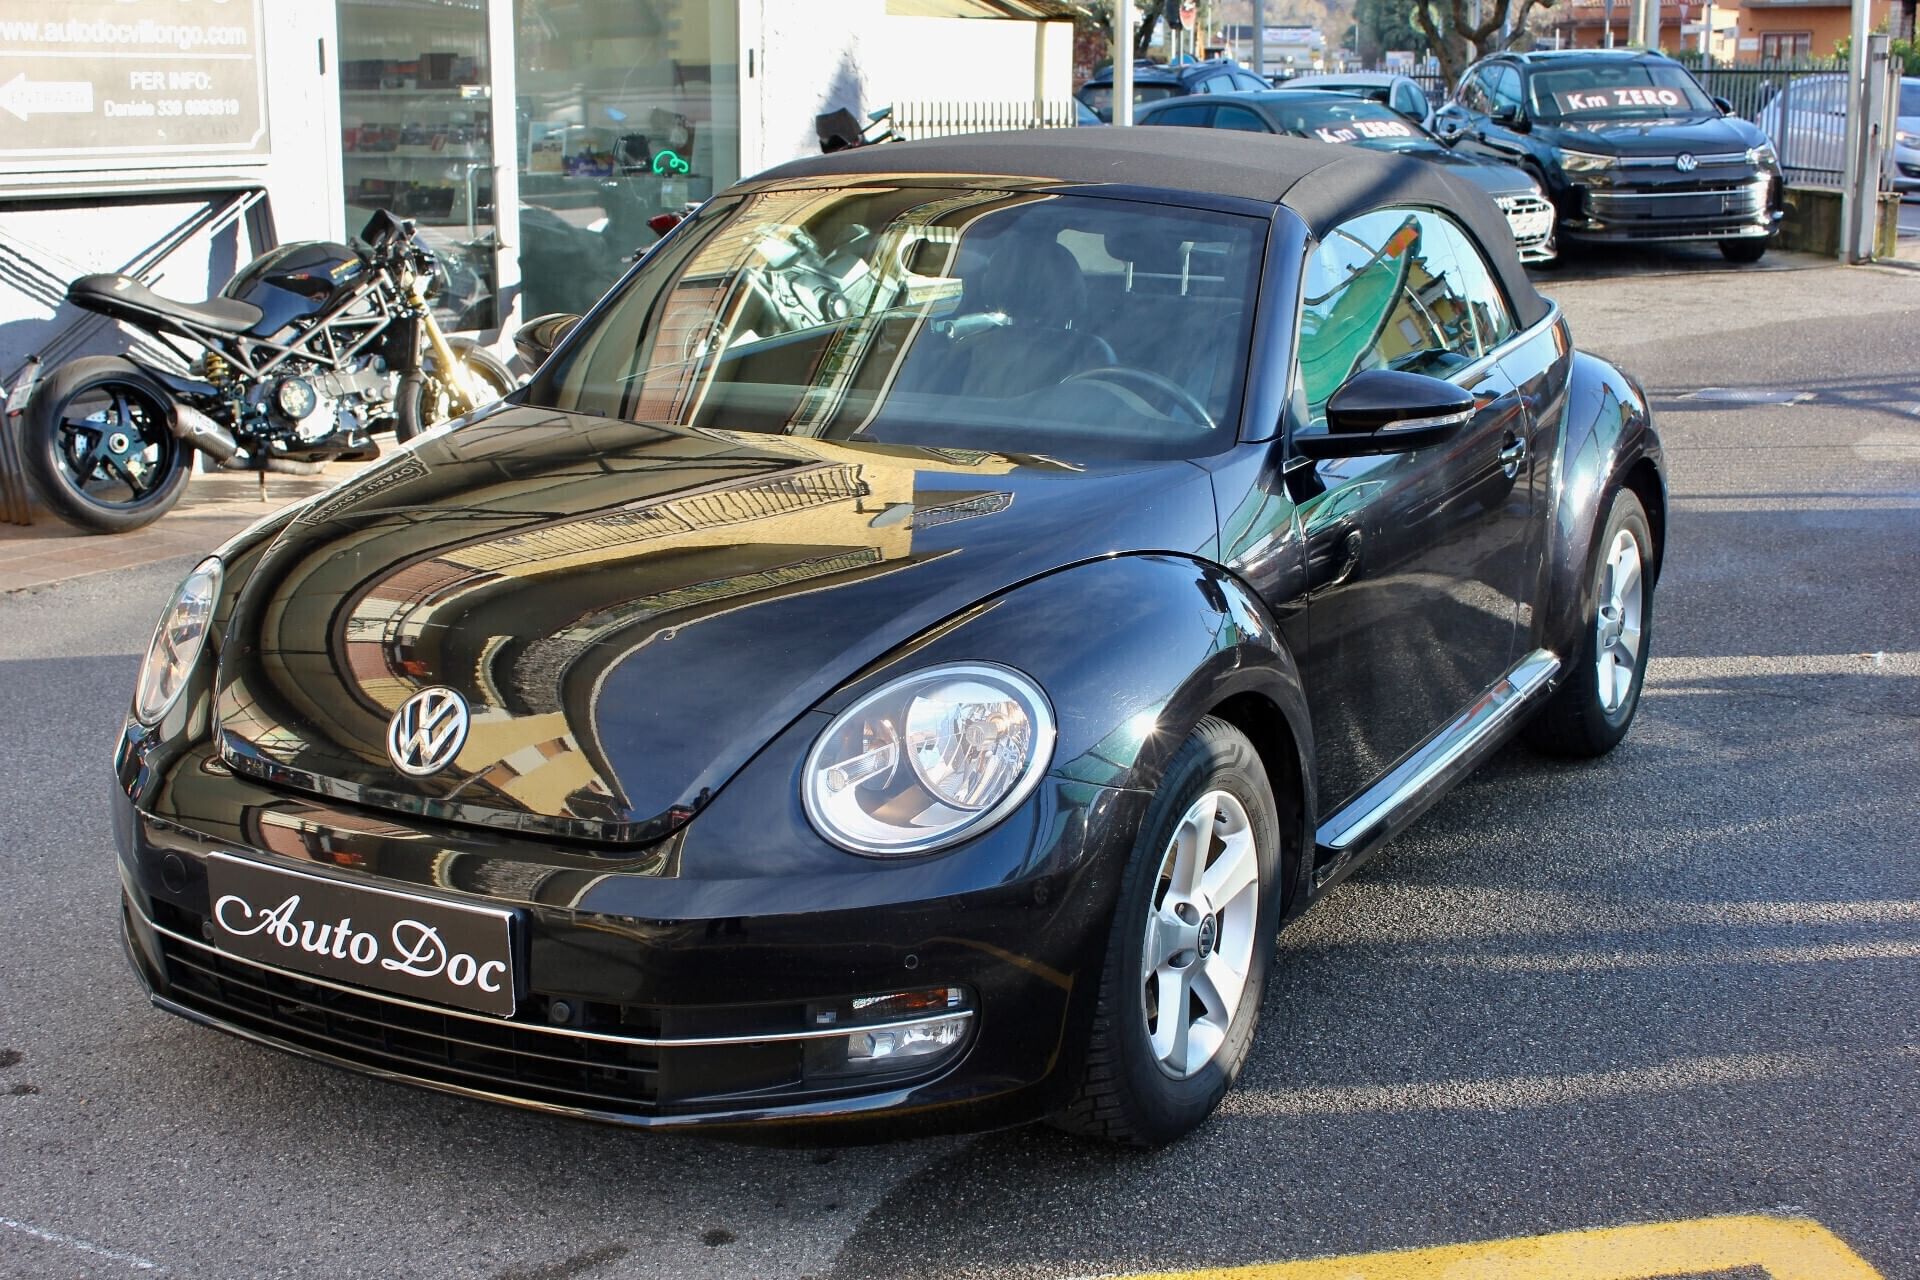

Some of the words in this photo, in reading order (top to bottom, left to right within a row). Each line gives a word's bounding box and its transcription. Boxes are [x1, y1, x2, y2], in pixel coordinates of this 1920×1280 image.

[0, 18, 248, 49] ww.autodocvillongo.com
[130, 71, 166, 91] PER
[168, 71, 213, 91] INFO:
[1567, 93, 1608, 110] Km
[1613, 89, 1679, 106] ZERO
[1314, 128, 1358, 144] Km
[1353, 121, 1411, 138] ZERO
[214, 894, 379, 966] Auto
[380, 919, 508, 993] Doc
